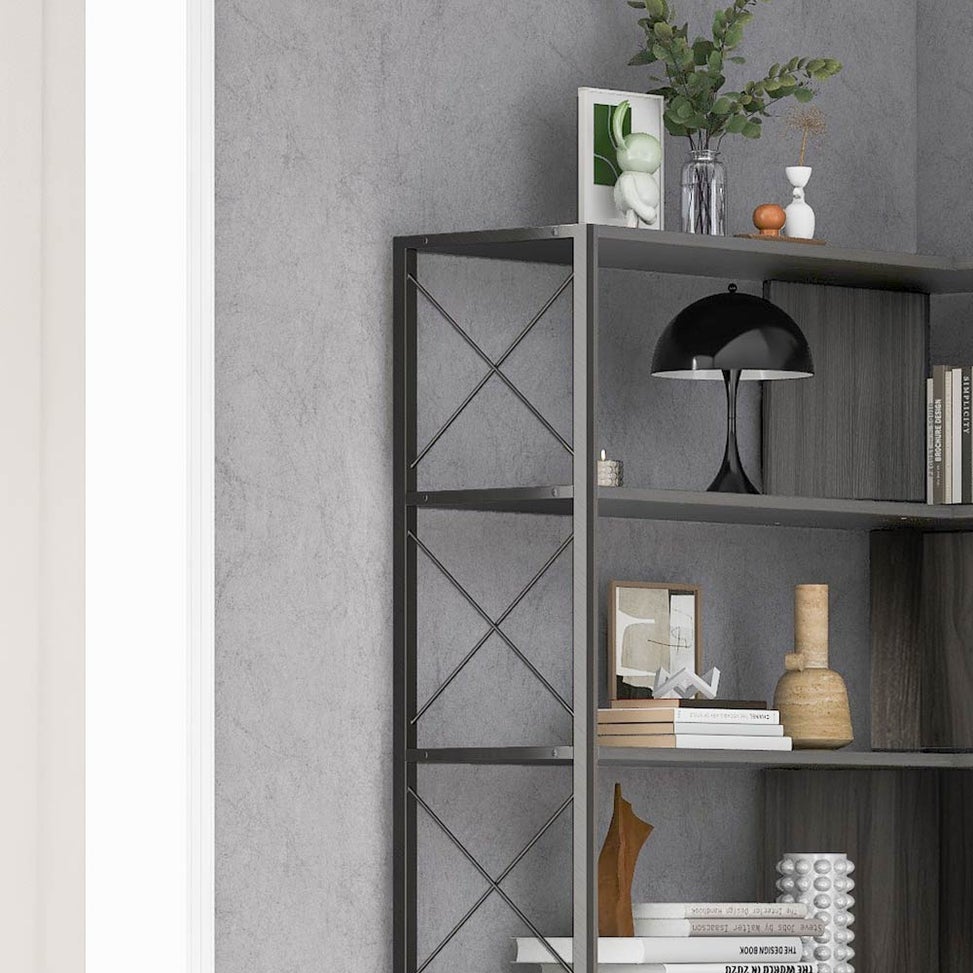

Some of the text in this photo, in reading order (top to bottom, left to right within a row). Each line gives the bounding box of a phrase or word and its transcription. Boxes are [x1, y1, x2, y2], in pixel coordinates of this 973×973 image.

[962, 375, 970, 434] SIMPLICITY
[934, 398, 942, 423] DESIGN
[934, 425, 942, 461] BROCHURE
[785, 908, 798, 916] The
[692, 923, 729, 934] Isaacson
[764, 922, 774, 934] by
[778, 923, 796, 934] Jobs
[801, 923, 822, 934] Steve
[739, 945, 797, 955] THE DESIGN BOOK
